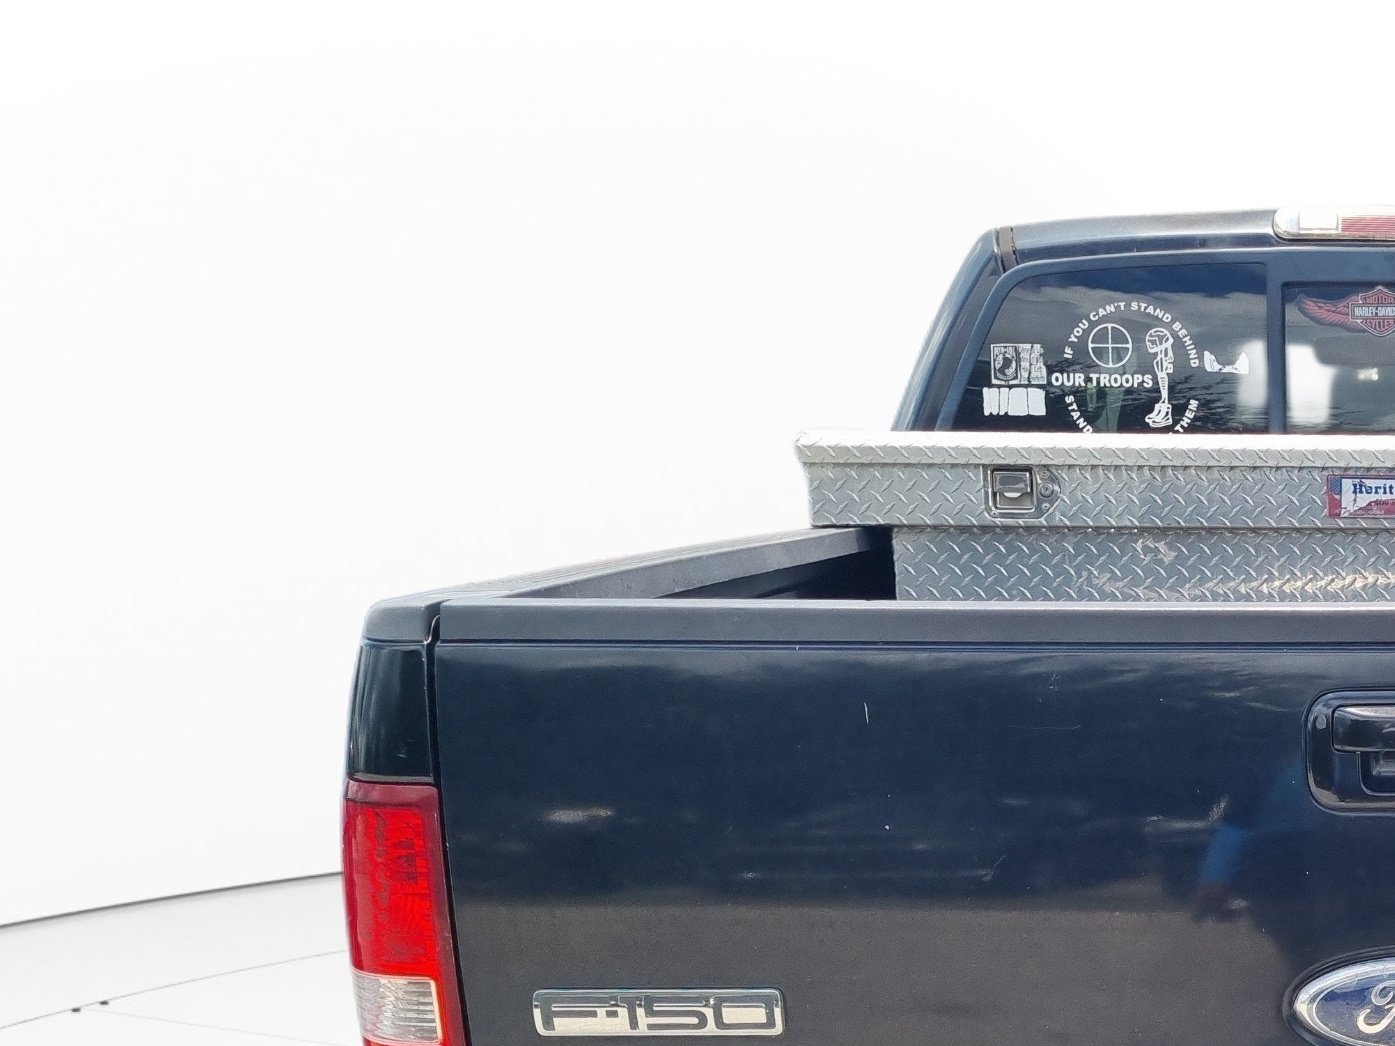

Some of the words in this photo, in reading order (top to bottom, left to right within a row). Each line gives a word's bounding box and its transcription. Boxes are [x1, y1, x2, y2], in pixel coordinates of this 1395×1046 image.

[1089, 302, 1126, 321] CAN'T
[1130, 302, 1172, 322] STAND
[1068, 319, 1089, 343] YOU
[1063, 345, 1075, 359] IF
[1171, 321, 1200, 368] BEHIND
[1051, 372, 1086, 387] OUR
[1089, 373, 1153, 388] TROOPS
[1064, 395, 1093, 434] STAND
[1173, 399, 1199, 433] THEM
[540, 992, 778, 1032] F-150
